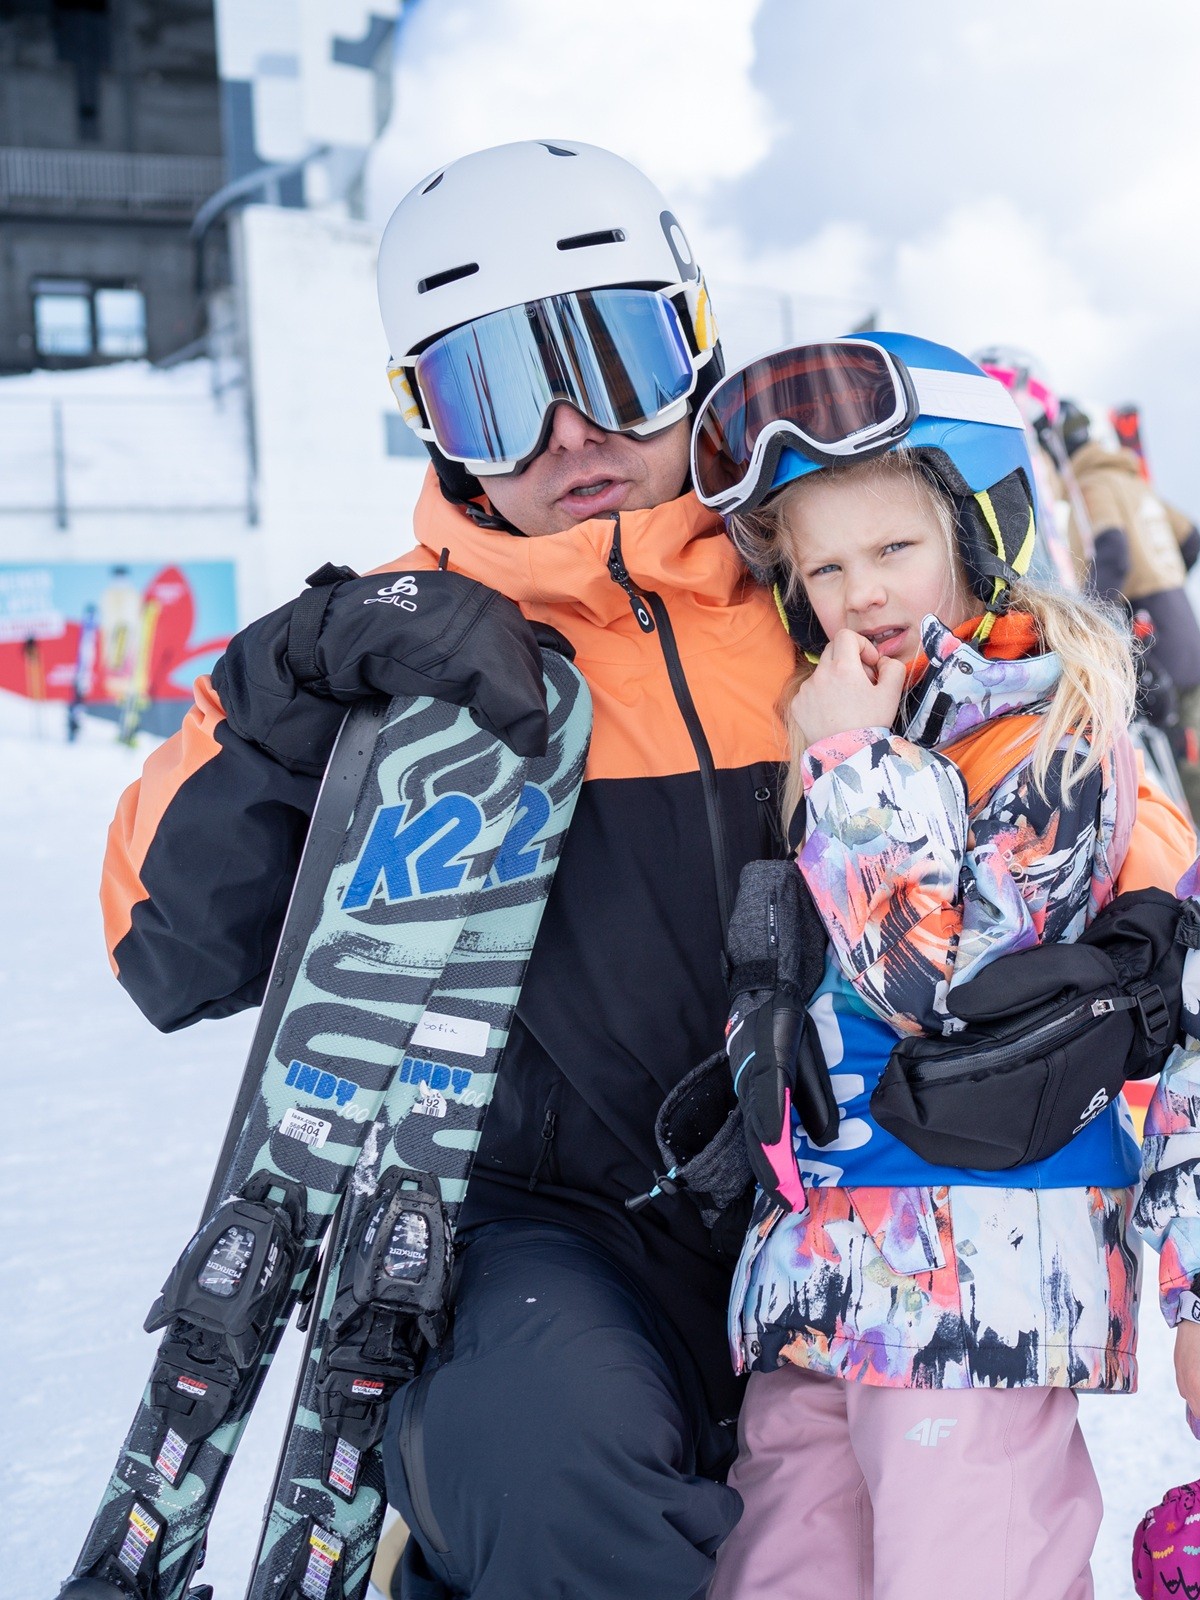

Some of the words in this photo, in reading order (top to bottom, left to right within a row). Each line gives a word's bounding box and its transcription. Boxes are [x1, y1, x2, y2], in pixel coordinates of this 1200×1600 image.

[482, 782, 553, 890] 2
[340, 793, 483, 910] K2
[284, 1059, 360, 1107] INDY
[400, 1056, 475, 1096] INDY
[389, 1247, 426, 1260] MARKER
[207, 1260, 242, 1279] MARKER
[178, 1375, 209, 1389] GRIP
[178, 1382, 206, 1395] WALK
[353, 1379, 384, 1388] GRIP
[353, 1386, 381, 1395] WALK
[904, 1417, 958, 1447] 4F
